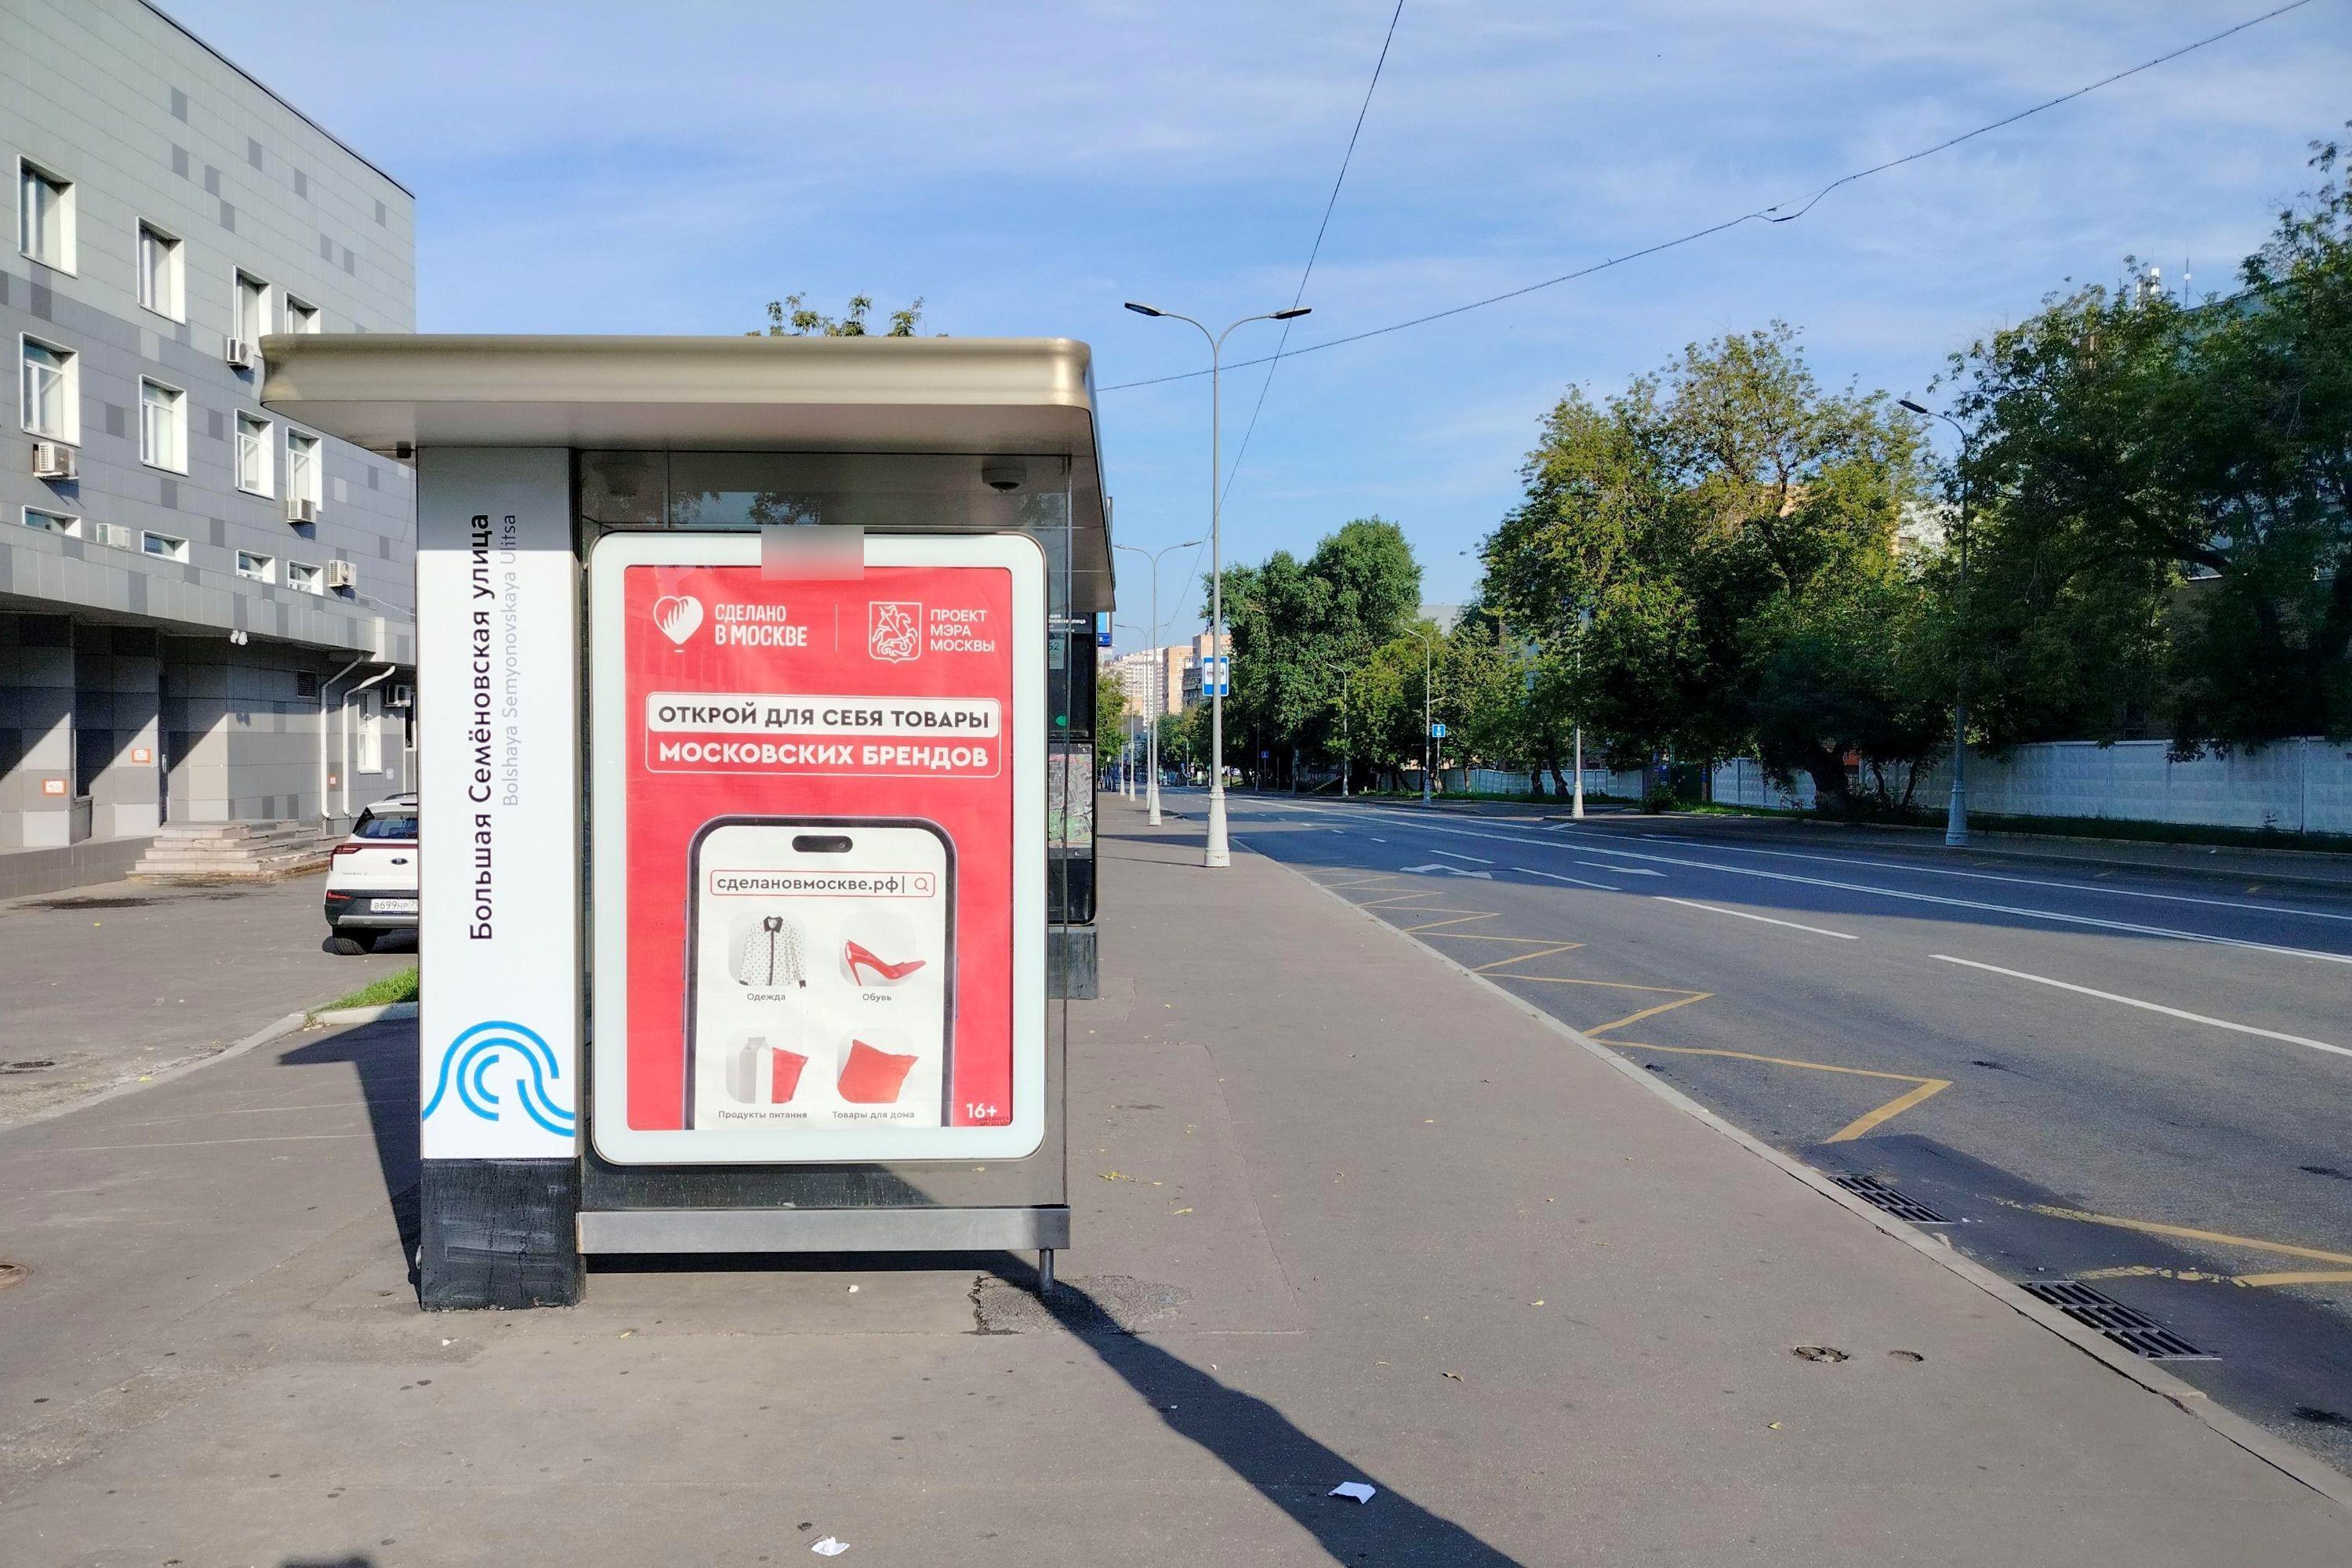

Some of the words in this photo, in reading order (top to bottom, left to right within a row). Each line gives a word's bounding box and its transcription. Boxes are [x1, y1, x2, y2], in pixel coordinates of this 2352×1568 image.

[500, 514, 516, 564] Ulitsa
[471, 514, 495, 599] улица
[714, 604, 786, 623] СДЕЛАНО
[930, 608, 988, 622] ПРОЕКТ
[715, 624, 727, 645] В
[730, 624, 808, 647] МОСКВЕ
[930, 623, 972, 637] МЭРА
[500, 572, 521, 718] Semyonovskaya
[930, 638, 996, 652] МОСКВЫ
[468, 612, 492, 803] Семёновская
[659, 702, 757, 724] ОТКРОЙ
[764, 708, 814, 728] ДЛЯ
[822, 709, 884, 727] СЕБЯ
[891, 710, 989, 728] ТОВАРЫ
[502, 726, 521, 805] Bolshaya
[659, 742, 855, 765] МОСКОВСКИХ
[862, 746, 989, 771] БРЕНДОВ
[469, 814, 492, 939] Большая
[746, 993, 786, 1001] Одежда
[862, 993, 892, 1002] Обувь
[718, 1110, 767, 1120] Продукты
[832, 1111, 868, 1120] Товары
[869, 1112, 887, 1120] для
[966, 1103, 998, 1119] 16+
